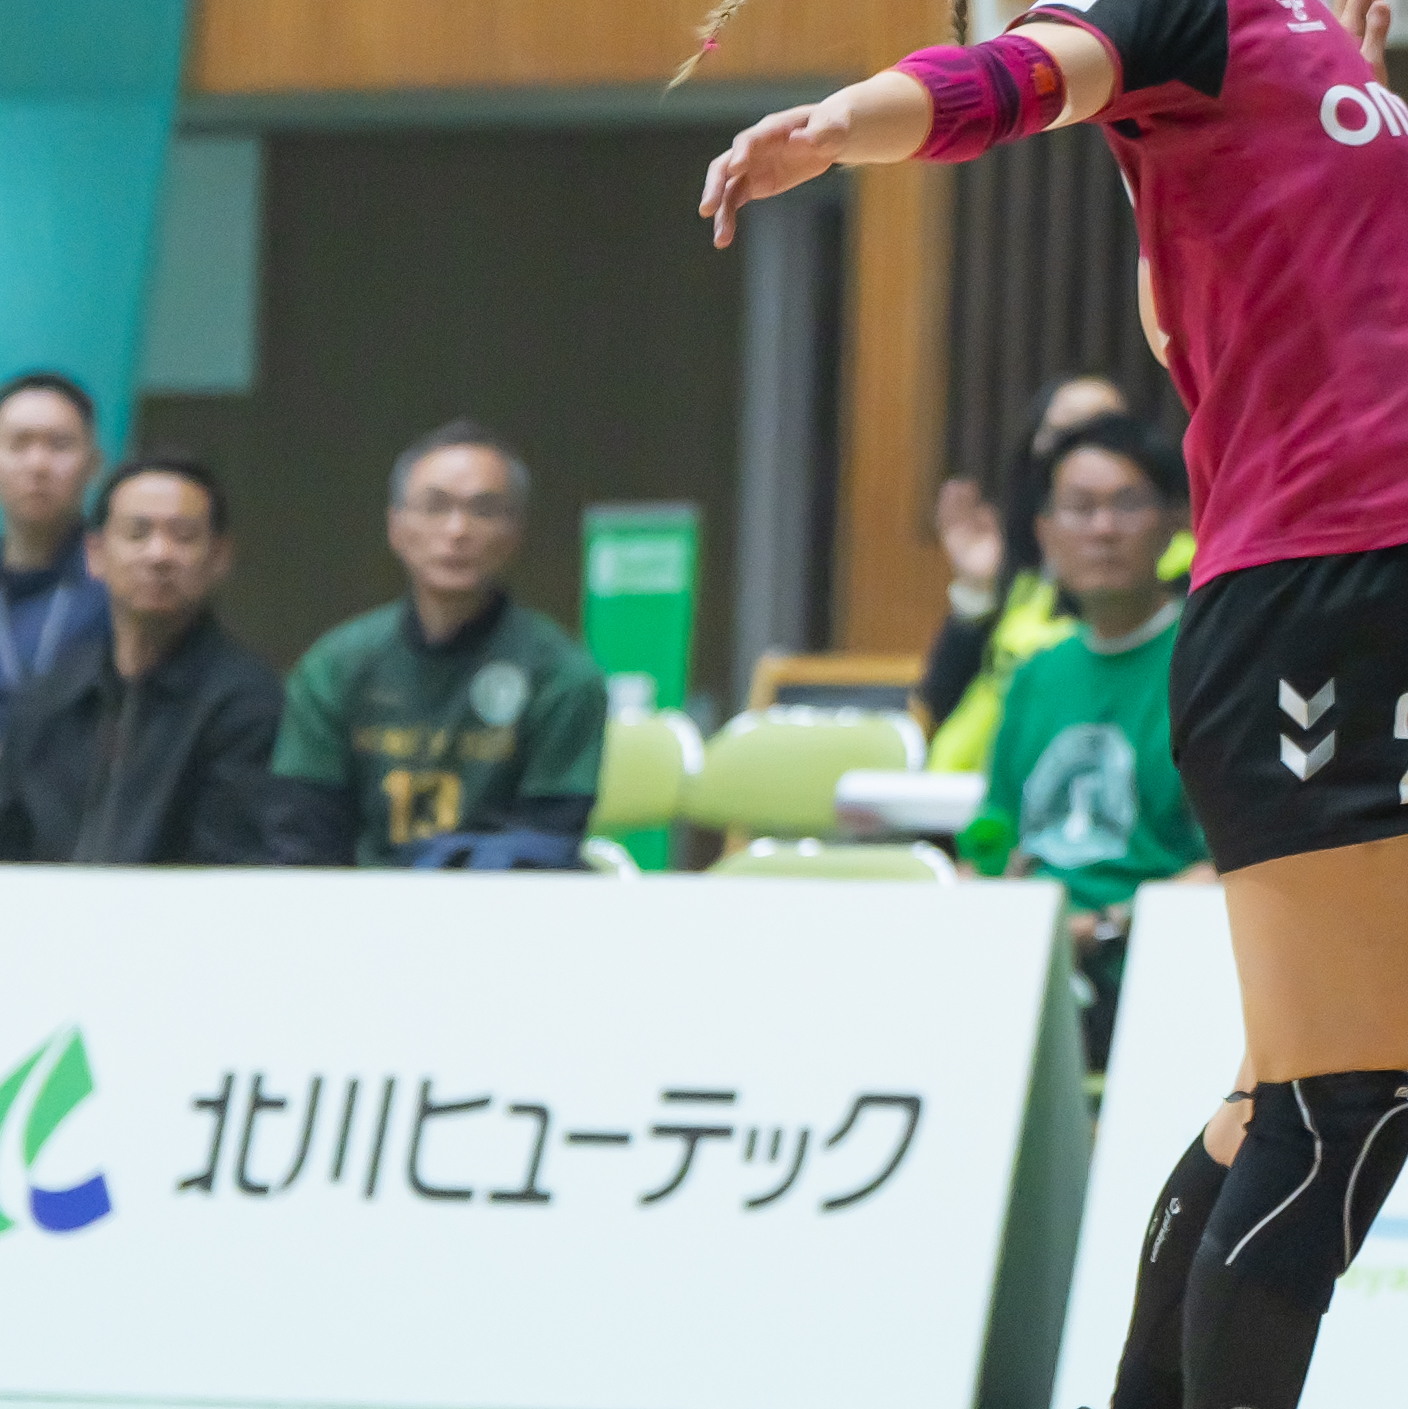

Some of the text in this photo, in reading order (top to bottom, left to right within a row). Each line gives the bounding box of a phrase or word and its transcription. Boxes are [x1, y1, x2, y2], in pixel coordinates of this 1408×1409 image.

[177, 1071, 923, 1213] 北川ヒューテック
